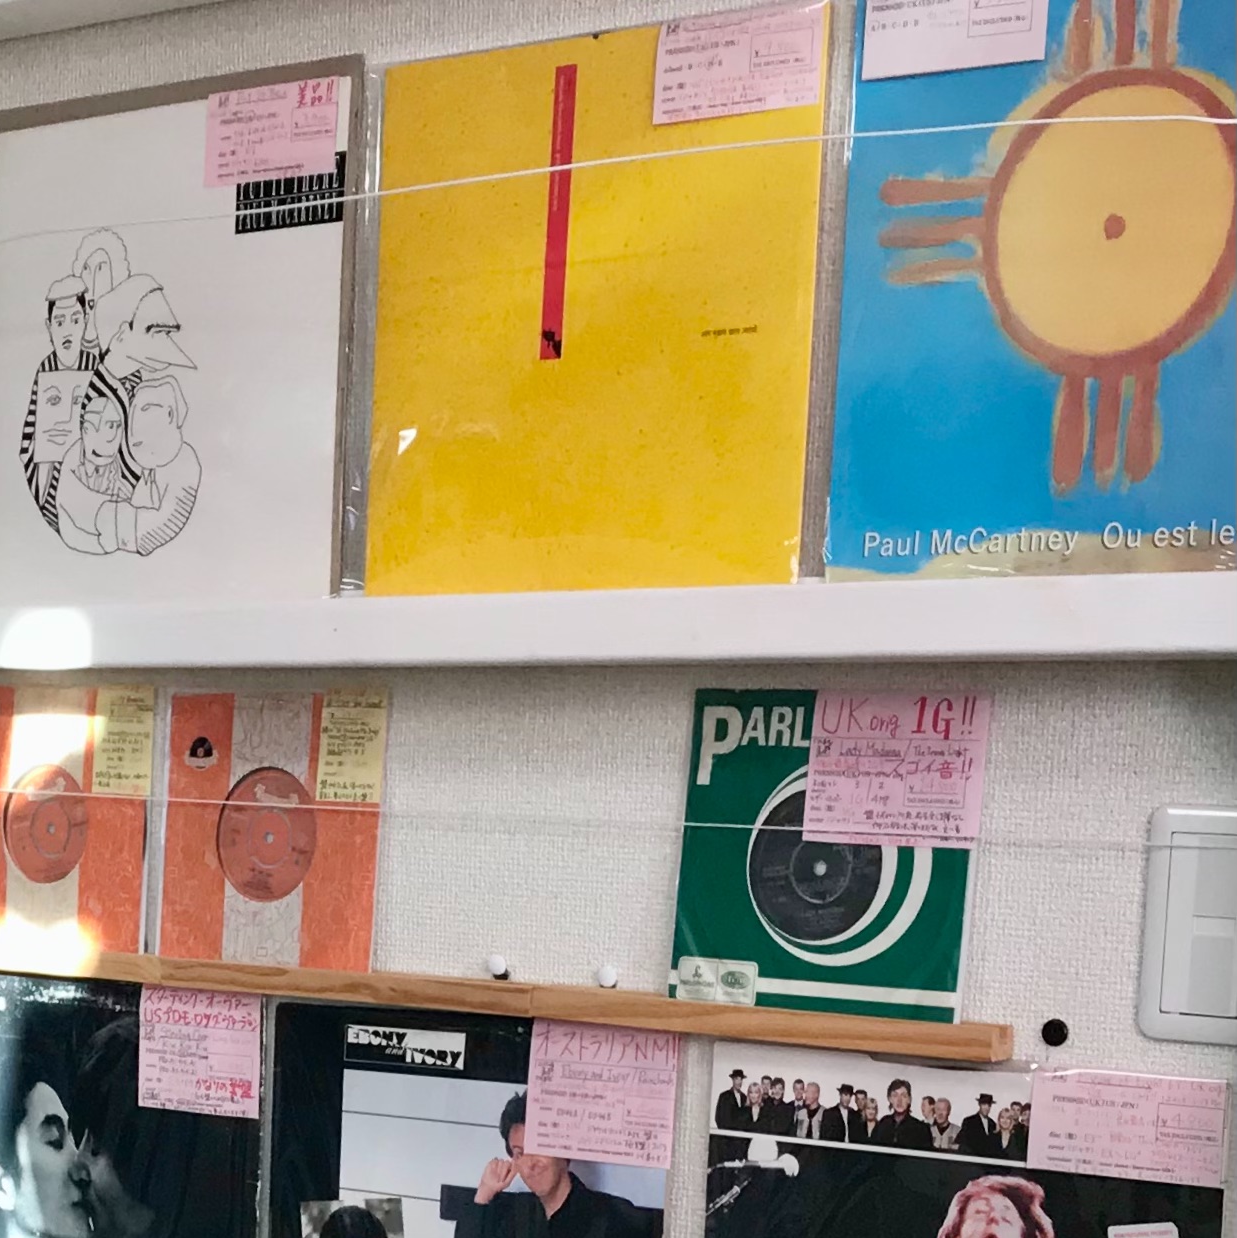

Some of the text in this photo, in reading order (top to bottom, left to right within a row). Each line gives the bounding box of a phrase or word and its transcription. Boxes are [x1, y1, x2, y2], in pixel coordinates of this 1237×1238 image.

[863, 518, 1235, 558] Paul McCartney Ou est le
[696, 705, 813, 786] PARL
[347, 1026, 410, 1048] EBONY
[405, 1046, 463, 1069] IVORY
